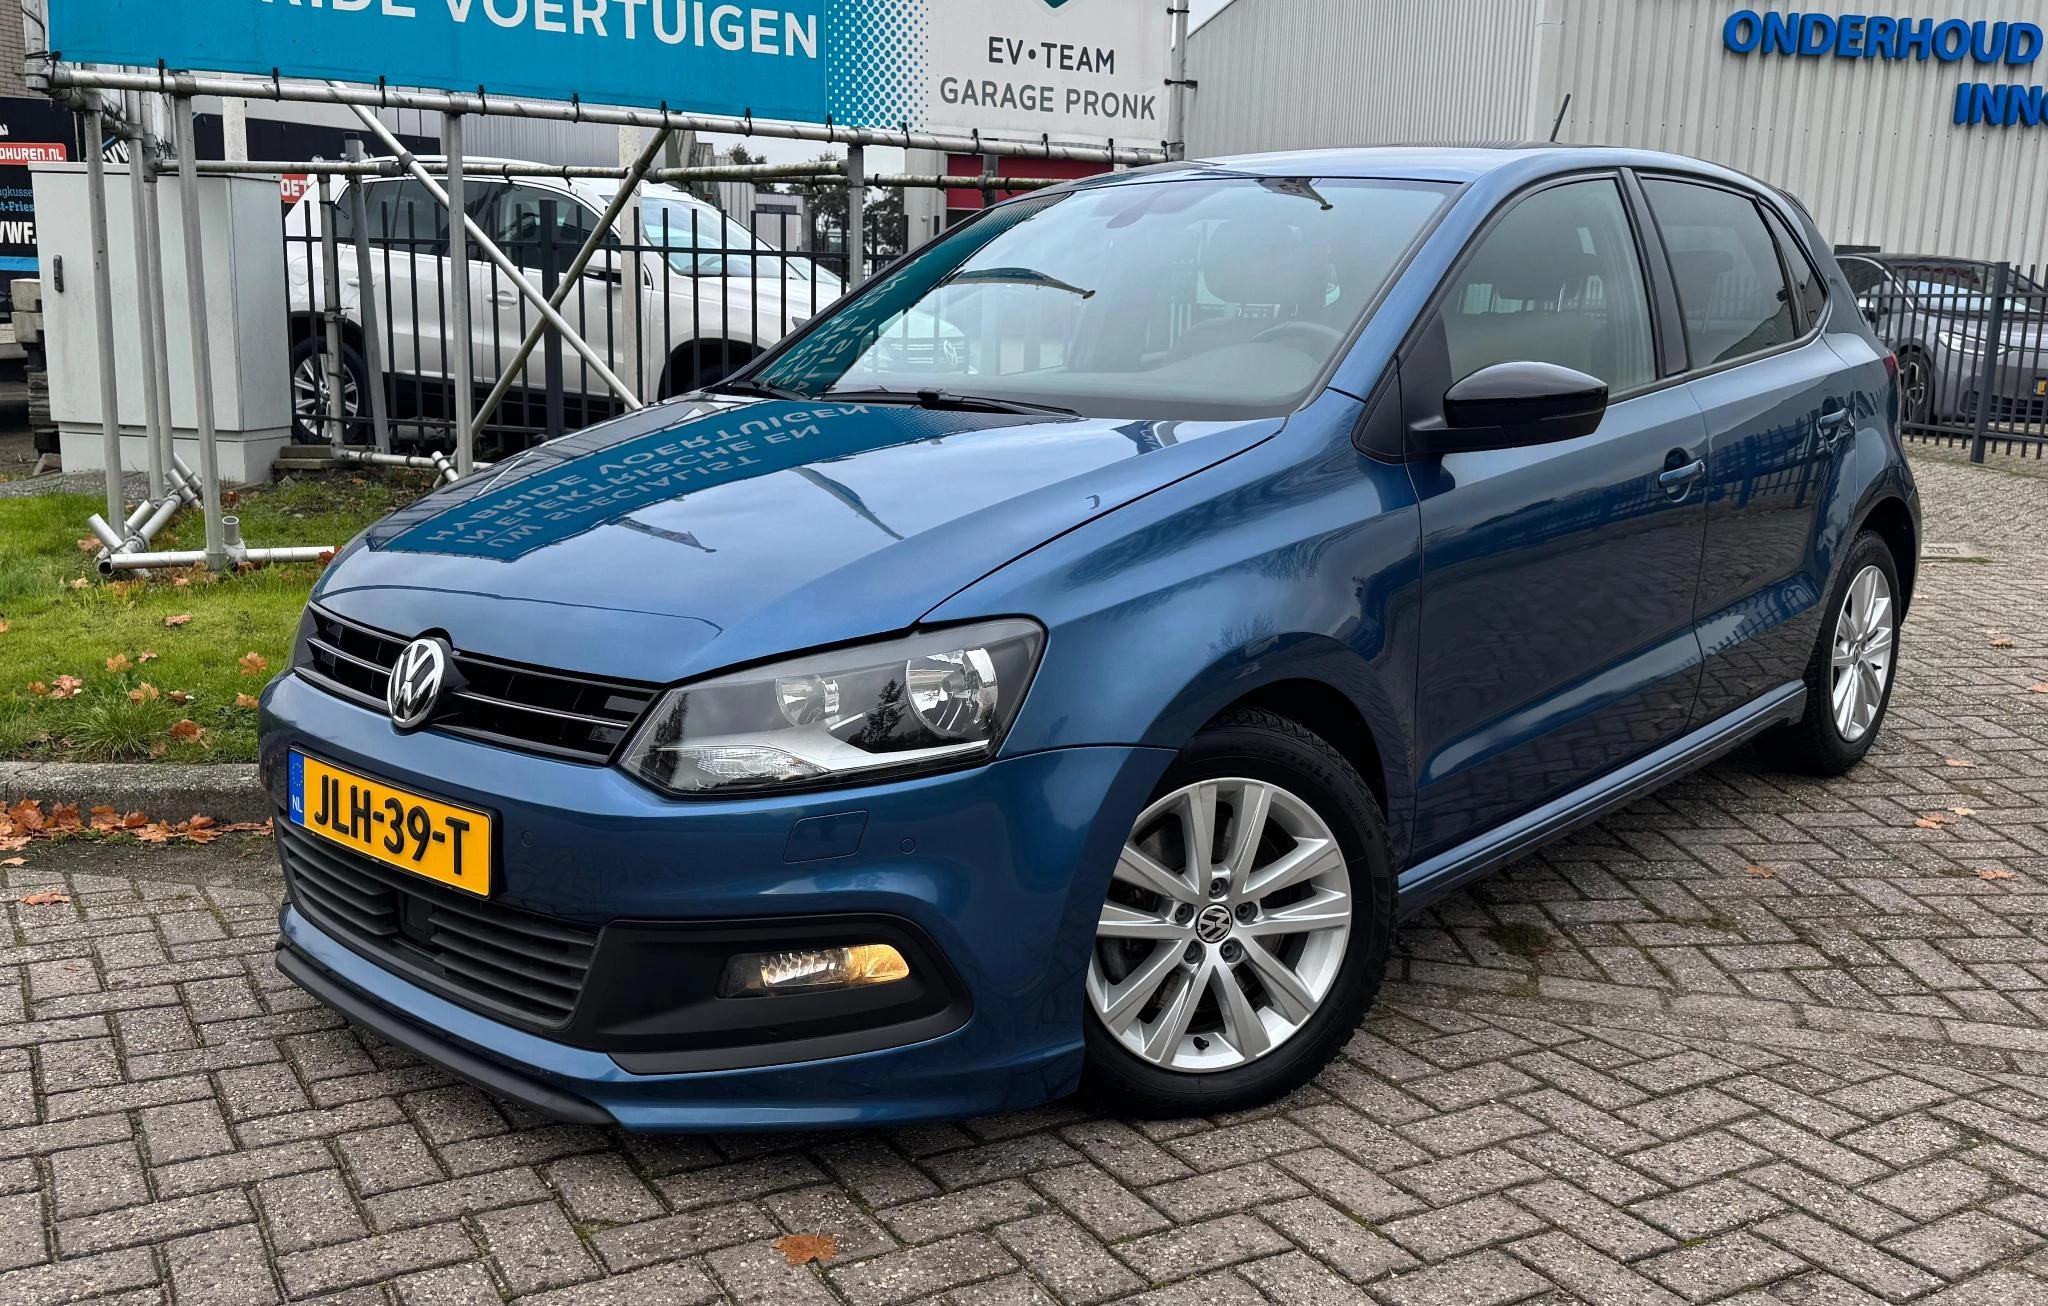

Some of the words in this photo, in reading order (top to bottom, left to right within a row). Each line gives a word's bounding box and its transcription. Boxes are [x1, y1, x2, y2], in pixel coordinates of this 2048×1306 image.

[446, 0, 818, 58] VOERTUIGEN
[1722, 10, 2044, 65] ONDERHOUD
[940, 76, 1054, 113] GARAGE
[1065, 87, 1156, 121] PRONK
[292, 794, 303, 813] NL
[314, 774, 470, 876] JLH-39-T
